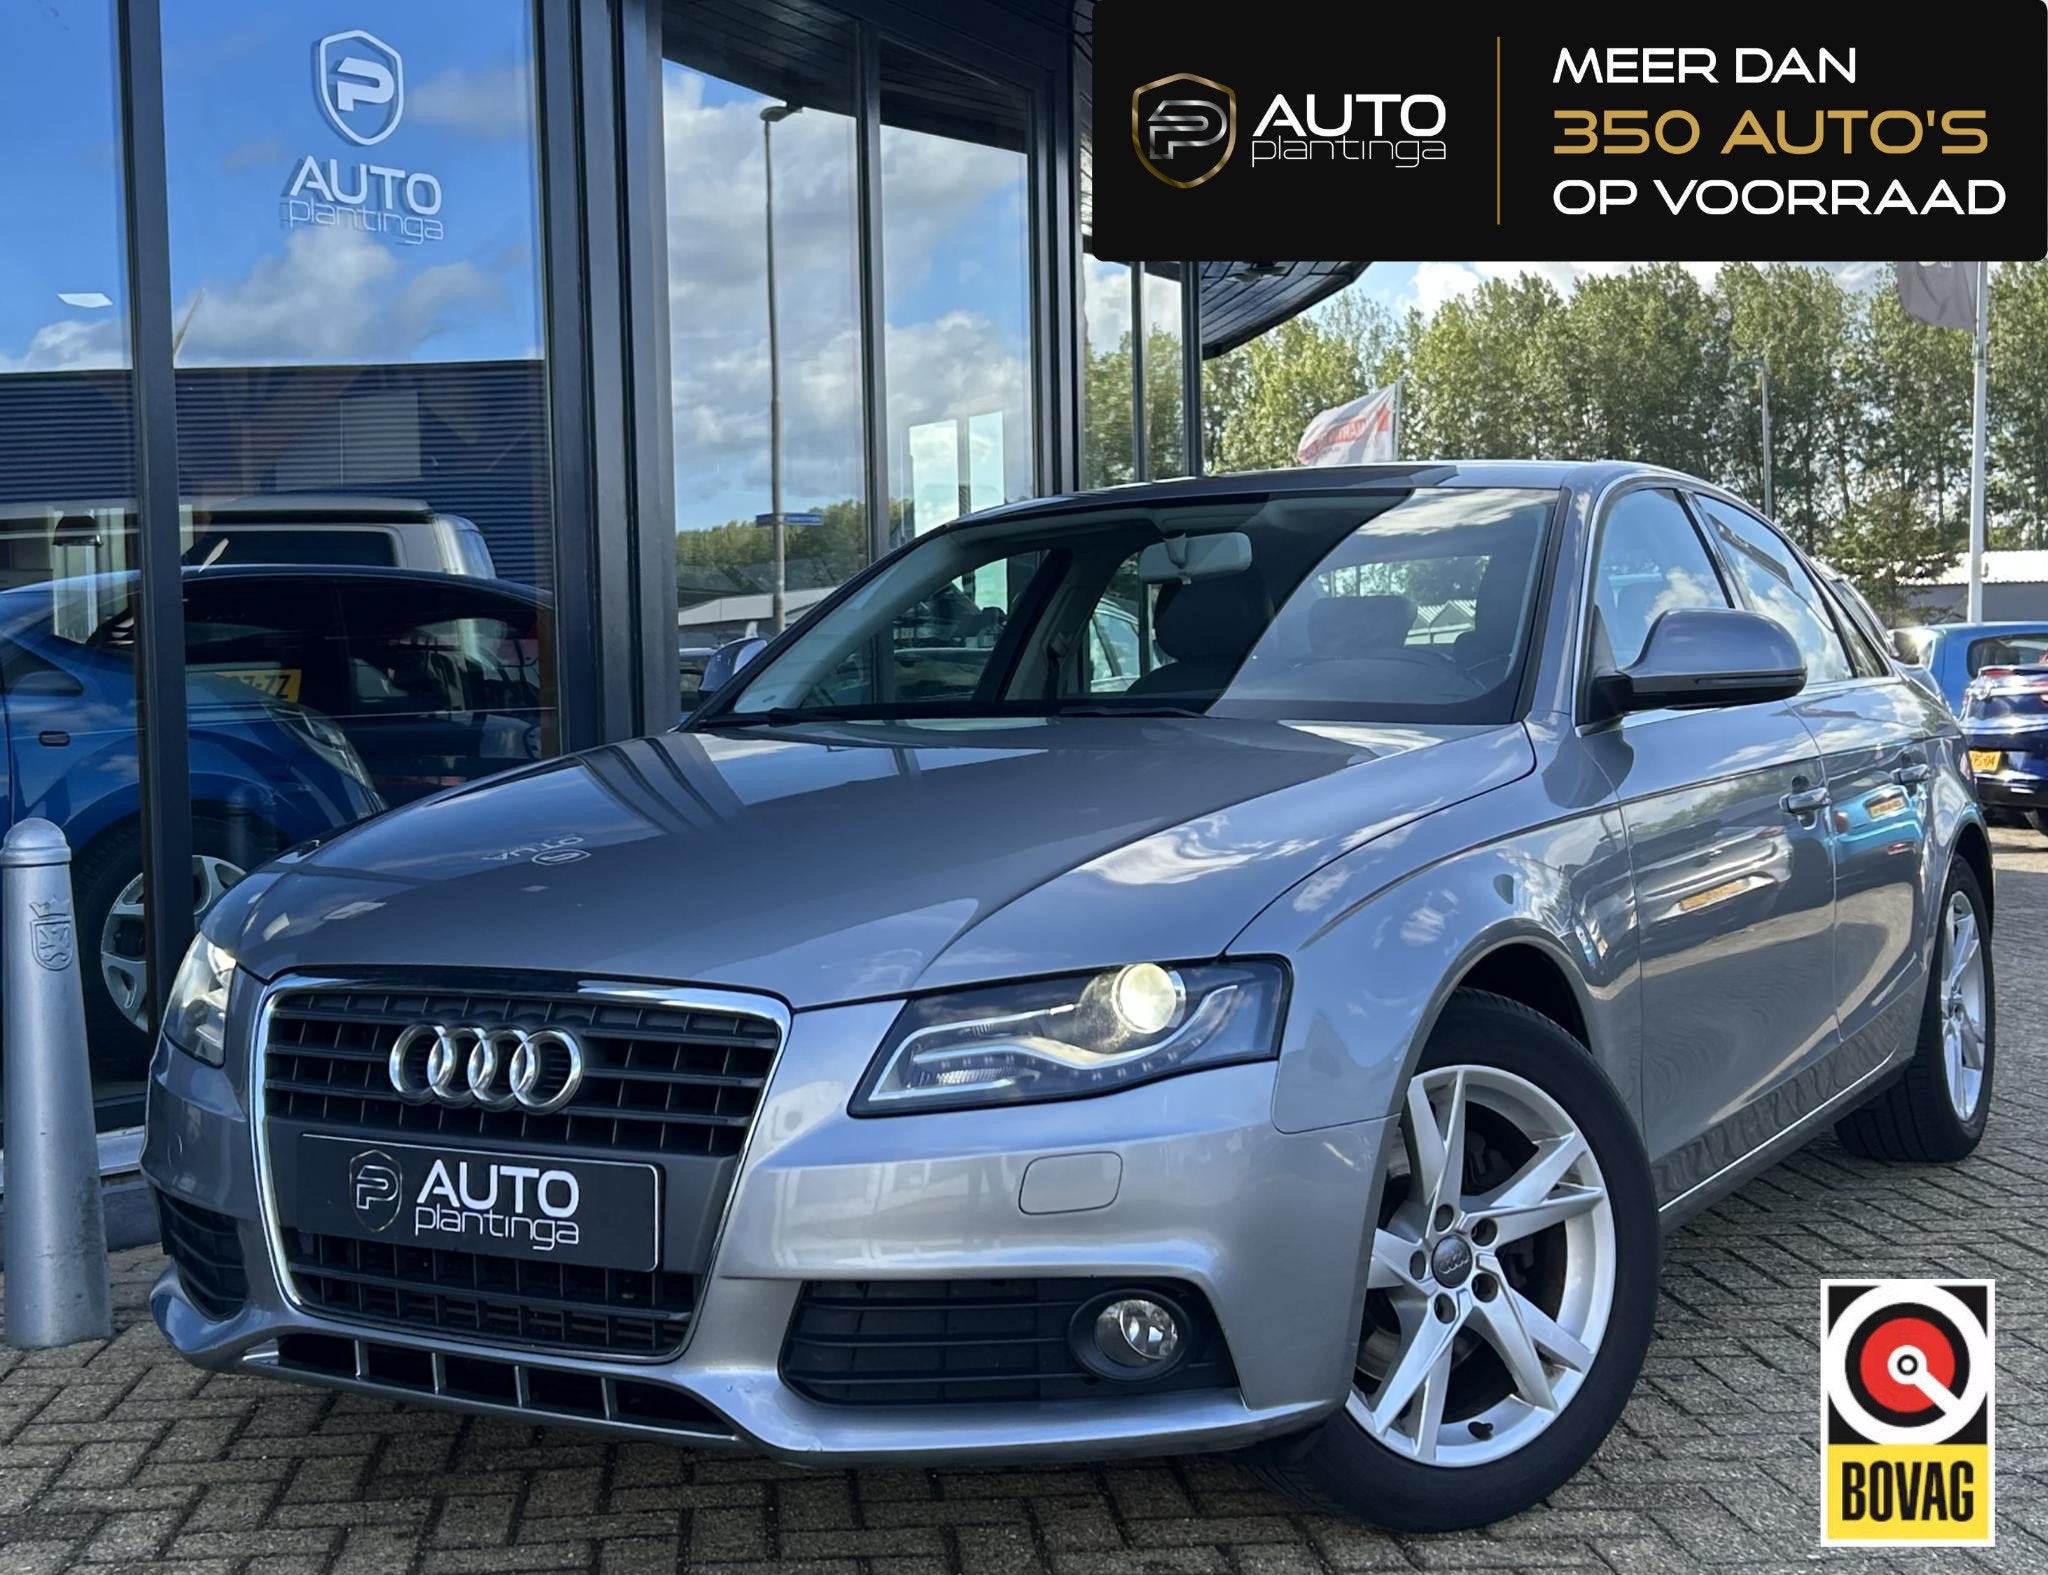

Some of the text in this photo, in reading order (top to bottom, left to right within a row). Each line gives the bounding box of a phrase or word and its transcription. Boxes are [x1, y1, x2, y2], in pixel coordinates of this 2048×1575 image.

[290, 155, 443, 216] AUTO
[290, 198, 444, 245] plantinga
[416, 1159, 580, 1218] AUTO
[415, 1203, 580, 1250] plantinga
